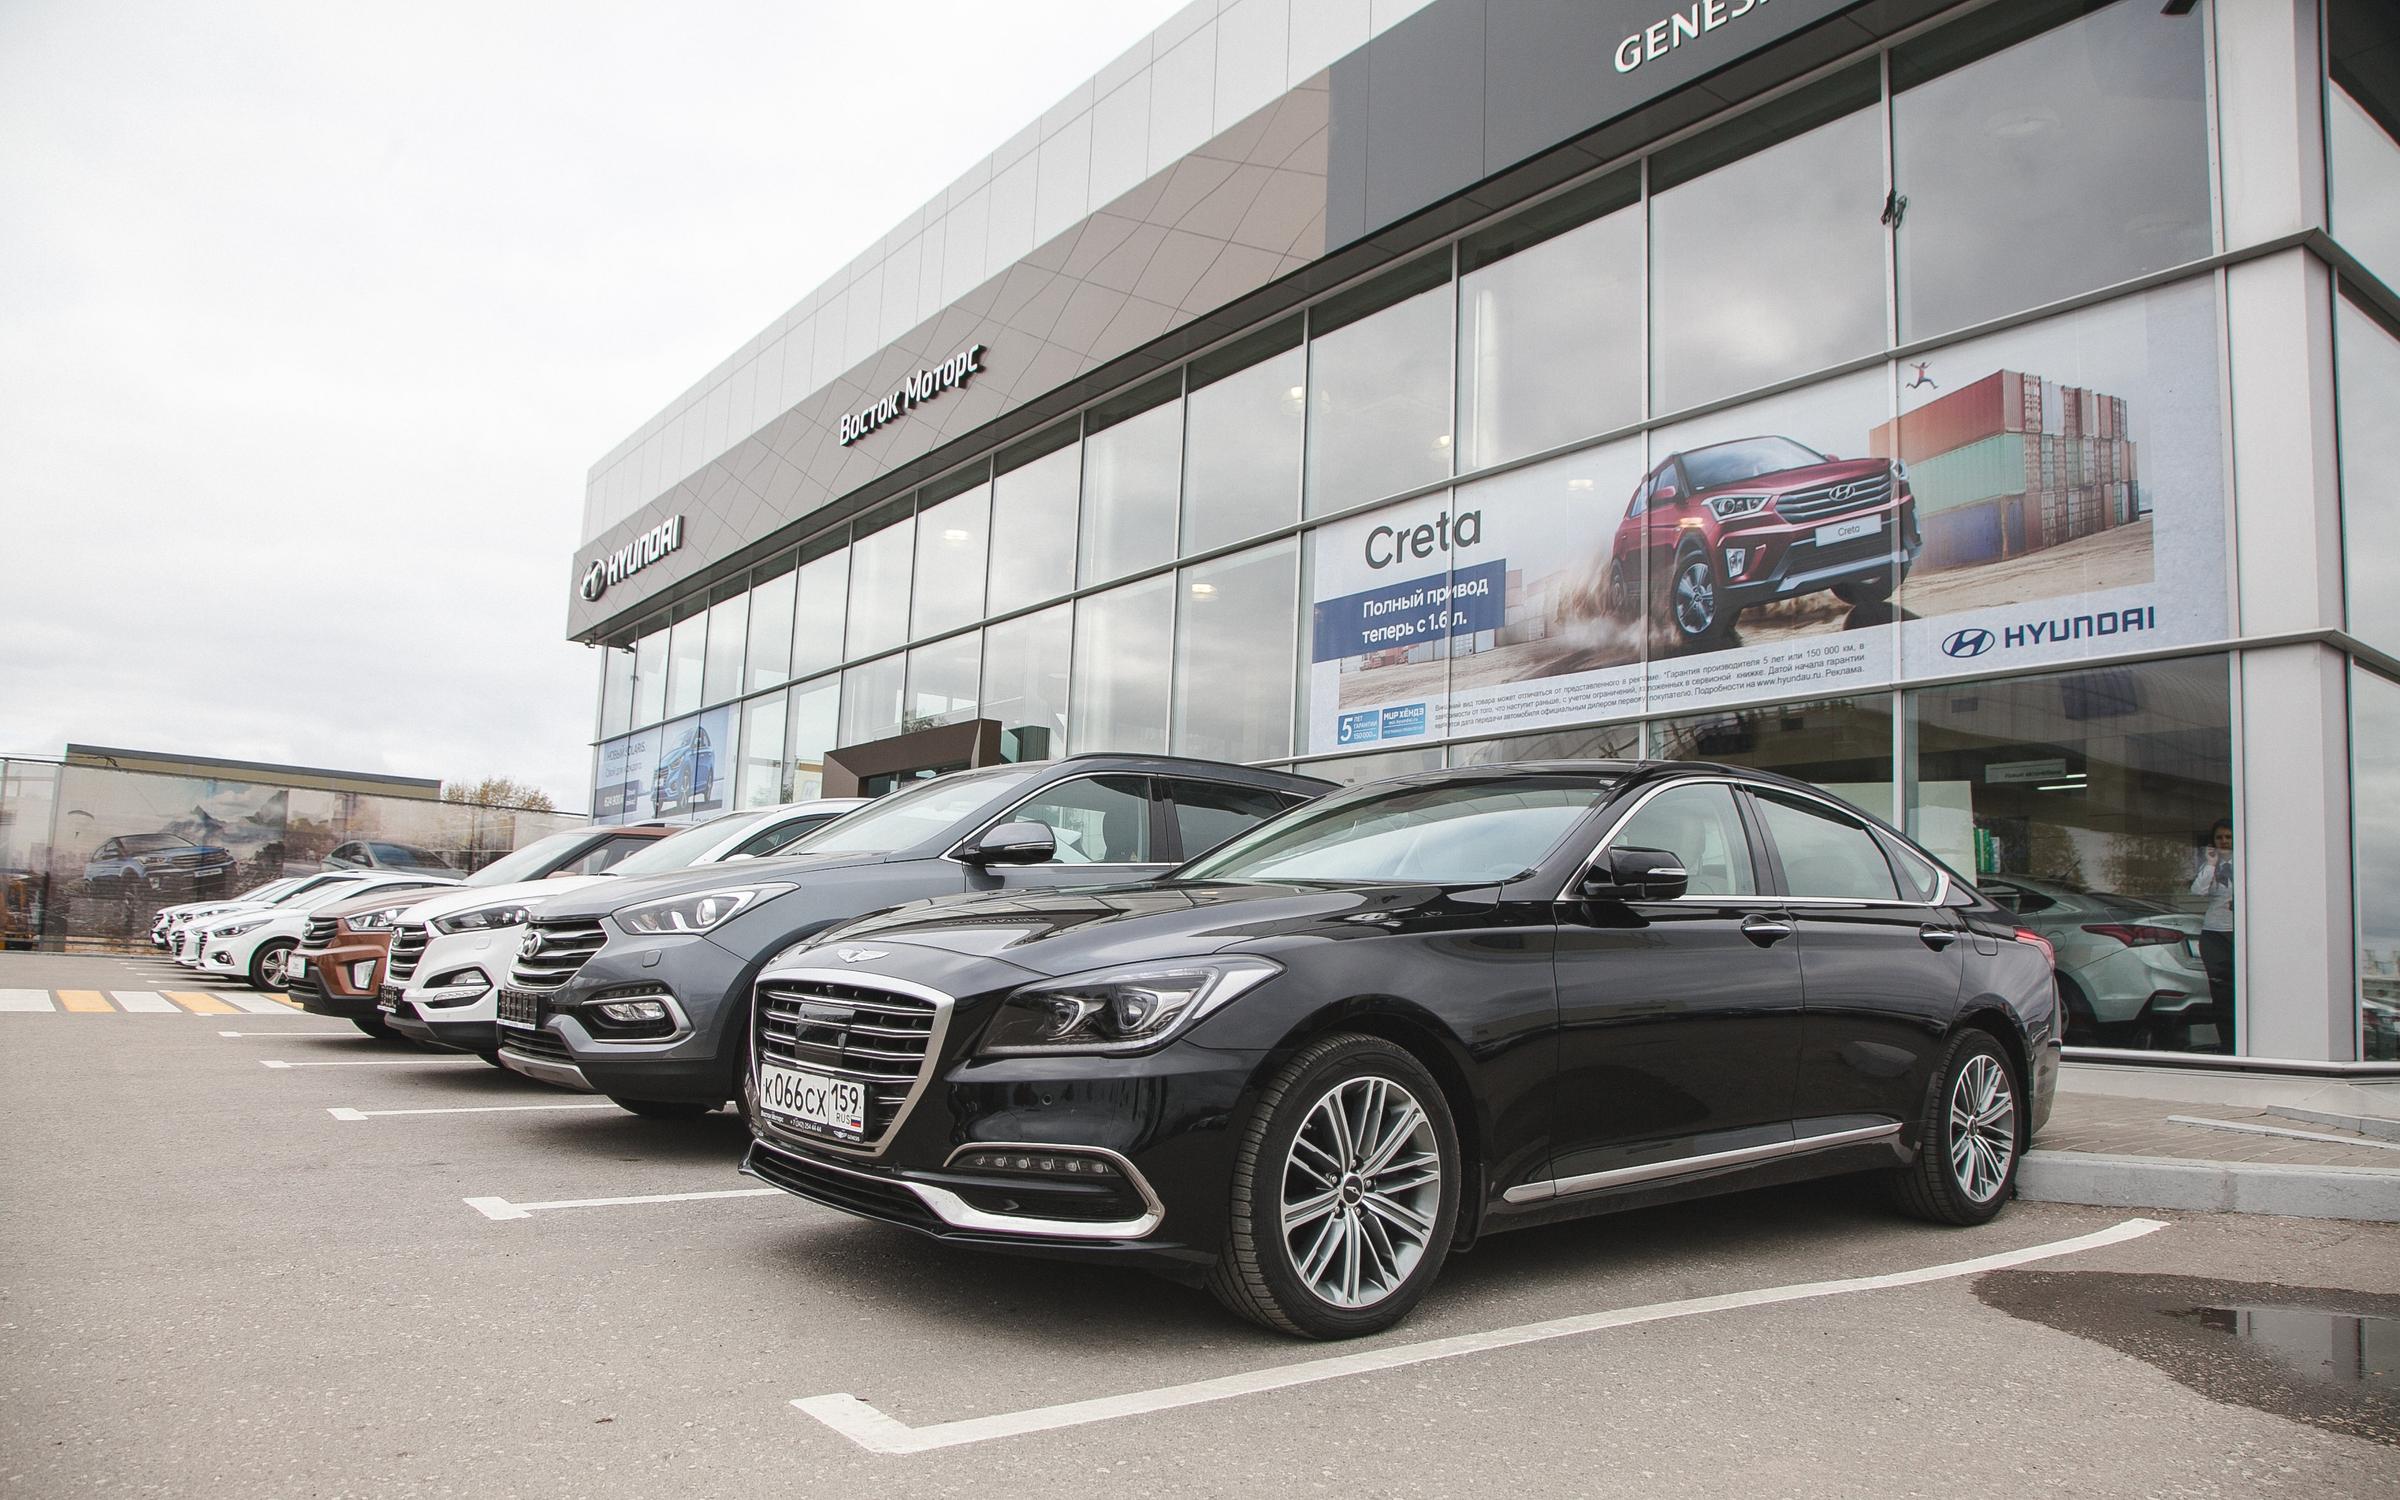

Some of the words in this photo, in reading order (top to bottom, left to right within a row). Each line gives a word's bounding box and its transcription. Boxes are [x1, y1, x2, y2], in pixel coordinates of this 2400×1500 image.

[1614, 0, 1768, 73] GENES
[840, 390, 900, 446] Восток
[904, 344, 980, 409] Моторс
[1365, 509, 1481, 569] Creta
[1838, 526, 1860, 537] Creta
[607, 514, 681, 586] HYUNDAI
[1363, 588, 1423, 618] Полный
[1427, 578, 1489, 606] привод
[1362, 621, 1414, 643] теперь
[1417, 619, 1426, 633] с
[1428, 610, 1447, 630] 1.6
[1452, 611, 1467, 626] л.
[2005, 606, 2154, 648] HYUNDAI
[1703, 659, 1760, 673] производителя
[1763, 656, 1768, 664] 5
[1771, 655, 1784, 663] лет
[1807, 648, 1821, 657] 150
[1824, 645, 1839, 655] 000
[1768, 664, 1793, 675] Датой
[1795, 660, 1824, 671] начала
[1827, 655, 1865, 666] гарантии
[1695, 683, 1744, 696] Подробности
[1826, 665, 1865, 677] Реклама.
[1340, 717, 1353, 742] 5
[831, 1083, 858, 1114] 159
[836, 1112, 850, 1124] RUS
